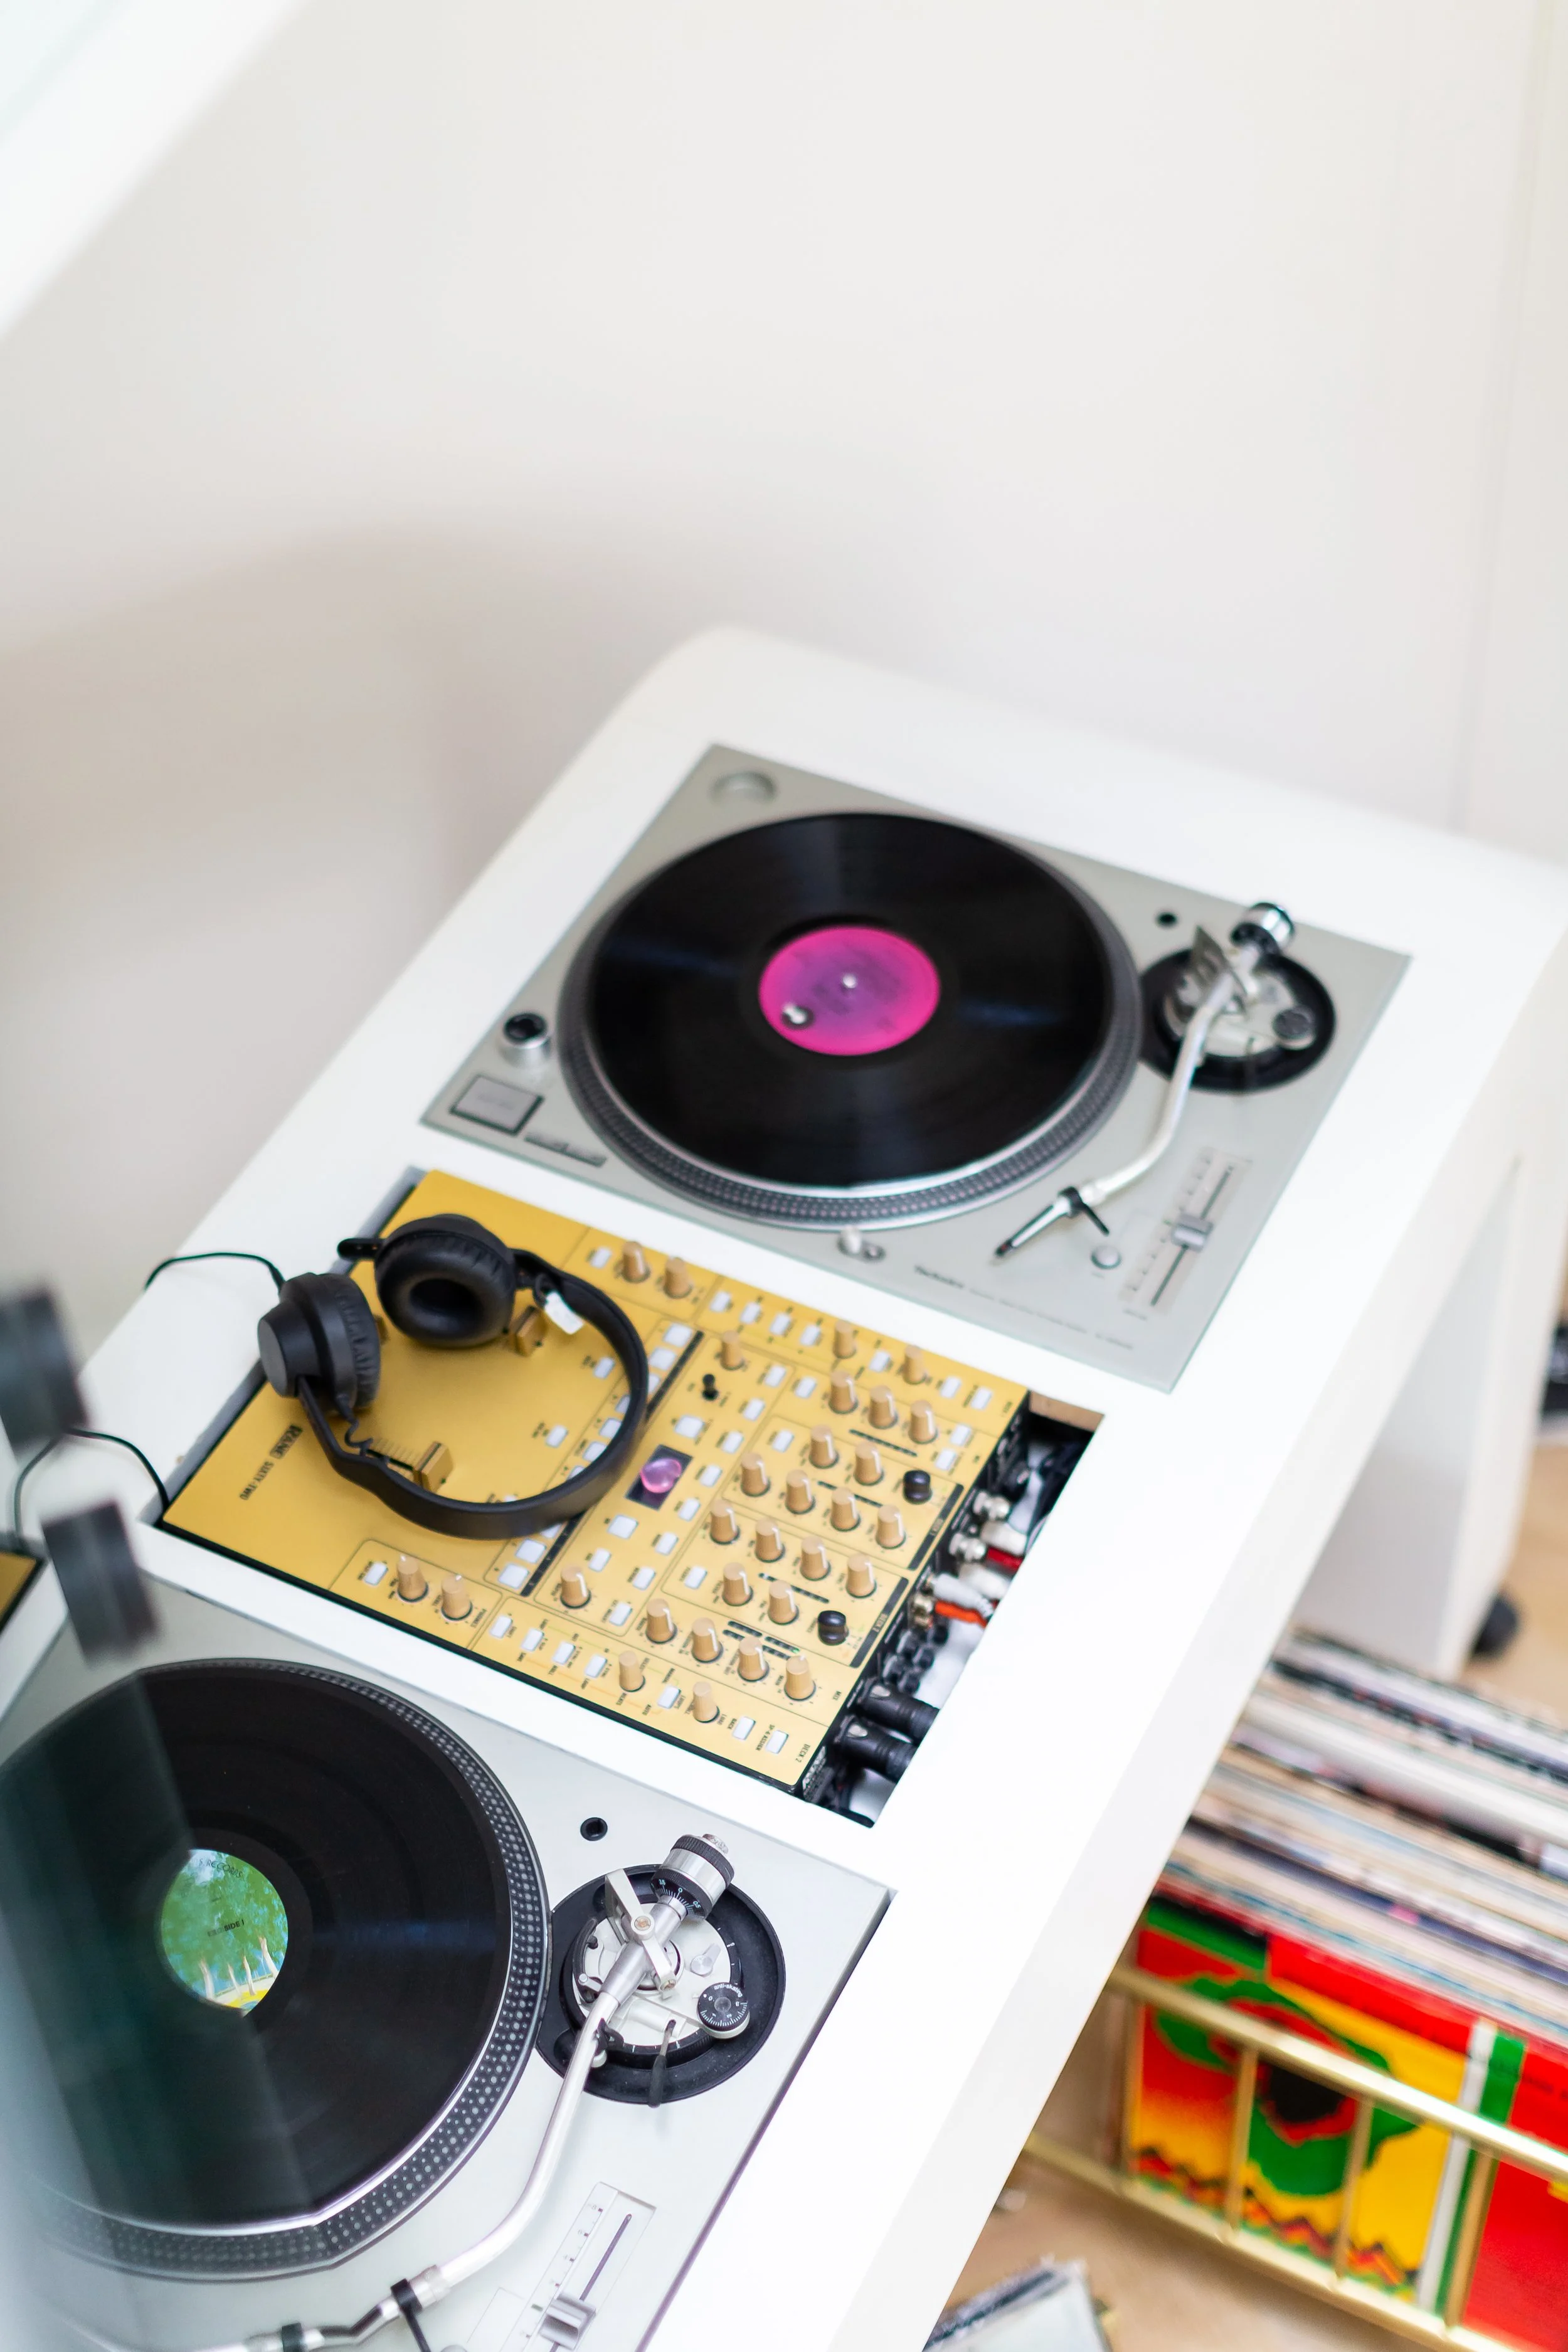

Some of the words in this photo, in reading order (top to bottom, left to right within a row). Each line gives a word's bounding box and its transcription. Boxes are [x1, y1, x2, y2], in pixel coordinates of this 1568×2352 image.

[268, 1424, 303, 1459] RANE
[239, 1461, 275, 1501] SIXTY-TWO
[642, 1704, 652, 1716] AUTO
[726, 1717, 737, 1729] BACK
[755, 1734, 768, 1751] ASSIGN
[797, 1744, 810, 1758] DECK
[223, 1920, 241, 1931] SIDE
[714, 1983, 743, 1998] anti-skating
